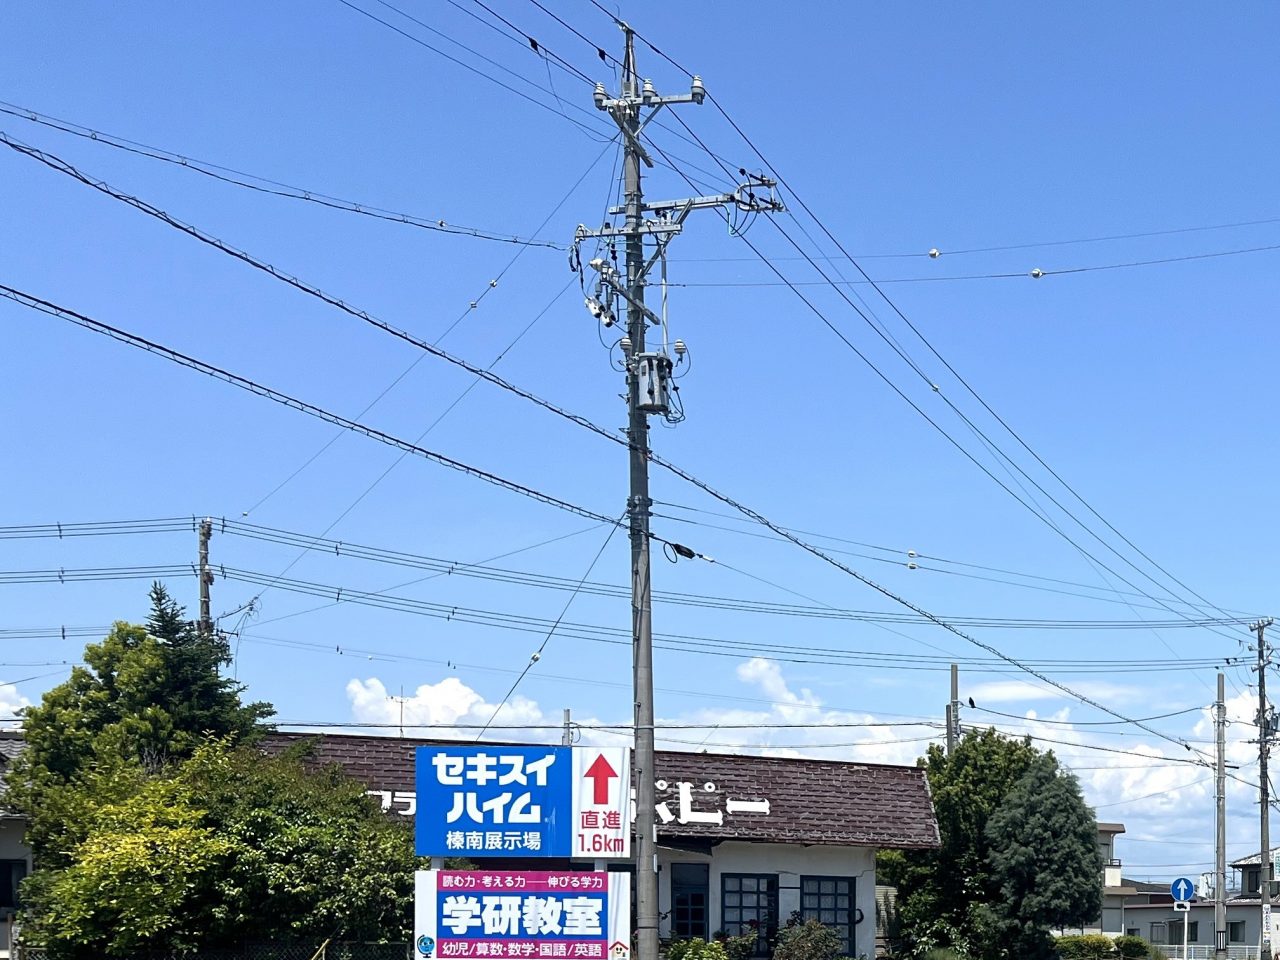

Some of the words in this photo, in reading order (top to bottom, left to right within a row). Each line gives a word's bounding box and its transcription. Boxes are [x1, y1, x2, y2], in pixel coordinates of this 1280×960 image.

[432, 753, 556, 786] セキスイ
[447, 792, 541, 823] ハイム
[581, 811, 621, 829] 直進
[447, 831, 541, 850] 榛南展示場
[578, 834, 624, 852] 1.6km
[442, 895, 602, 935] 学研教室
